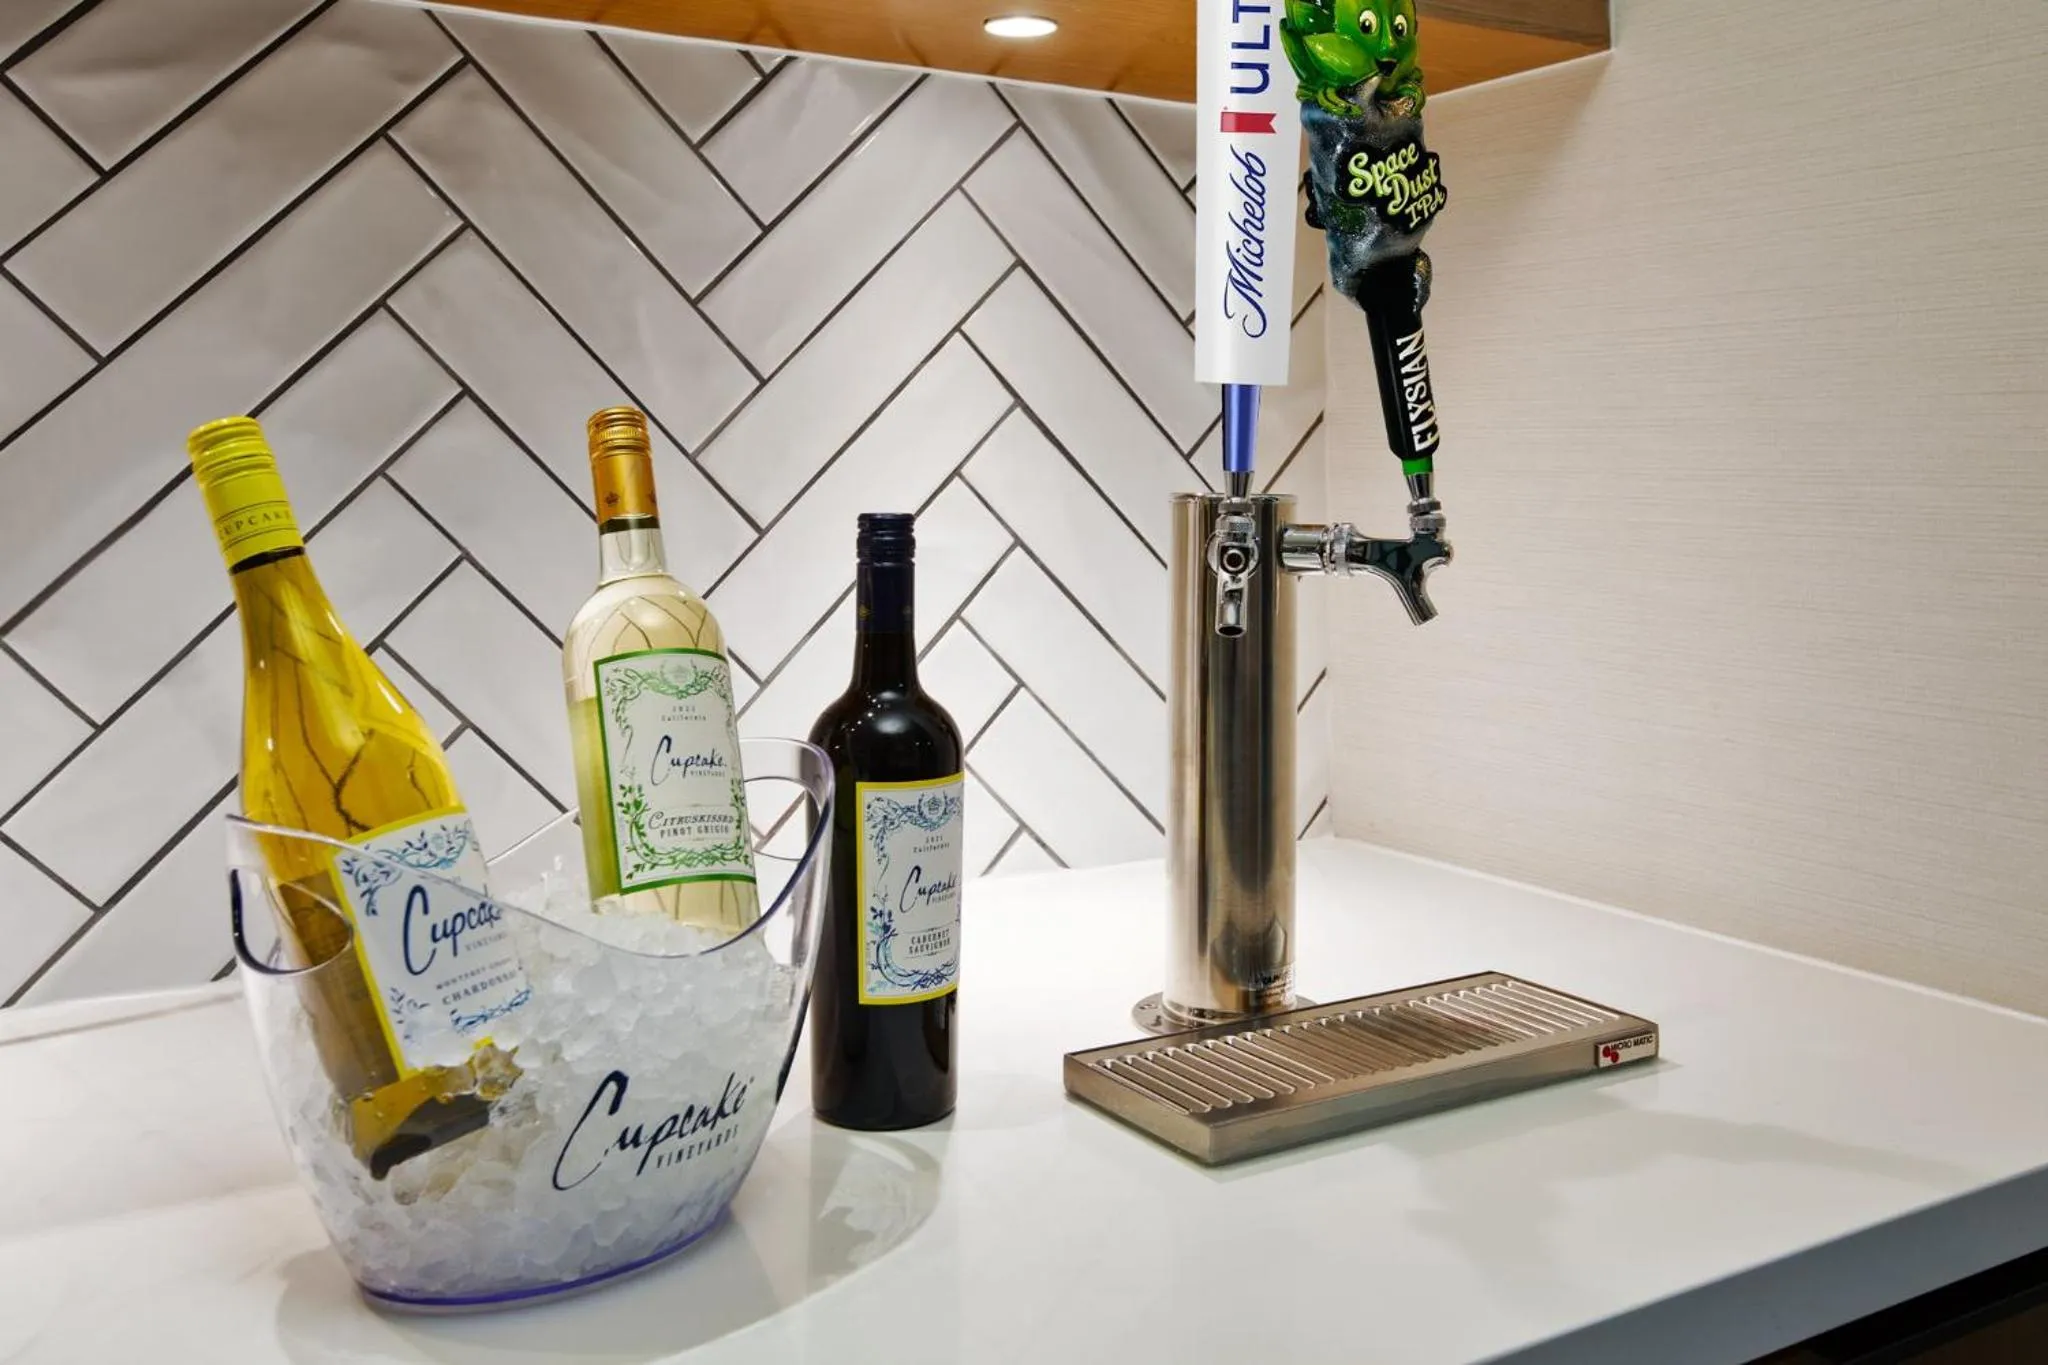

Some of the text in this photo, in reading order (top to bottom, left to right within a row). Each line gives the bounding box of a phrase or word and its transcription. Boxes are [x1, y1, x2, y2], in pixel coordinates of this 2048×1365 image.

[1347, 142, 1419, 198] Space
[1382, 158, 1438, 216] Dust
[1404, 186, 1445, 229] IPA
[1224, 144, 1267, 338] Michelob
[1396, 328, 1440, 452] ELYSIAN
[651, 734, 724, 786] Cupcake
[660, 825, 729, 839] PINOT GRIGIO
[911, 928, 950, 945] CABERNET
[552, 1070, 749, 1191] Cupcake
[656, 1123, 739, 1169] VINEYARDS
